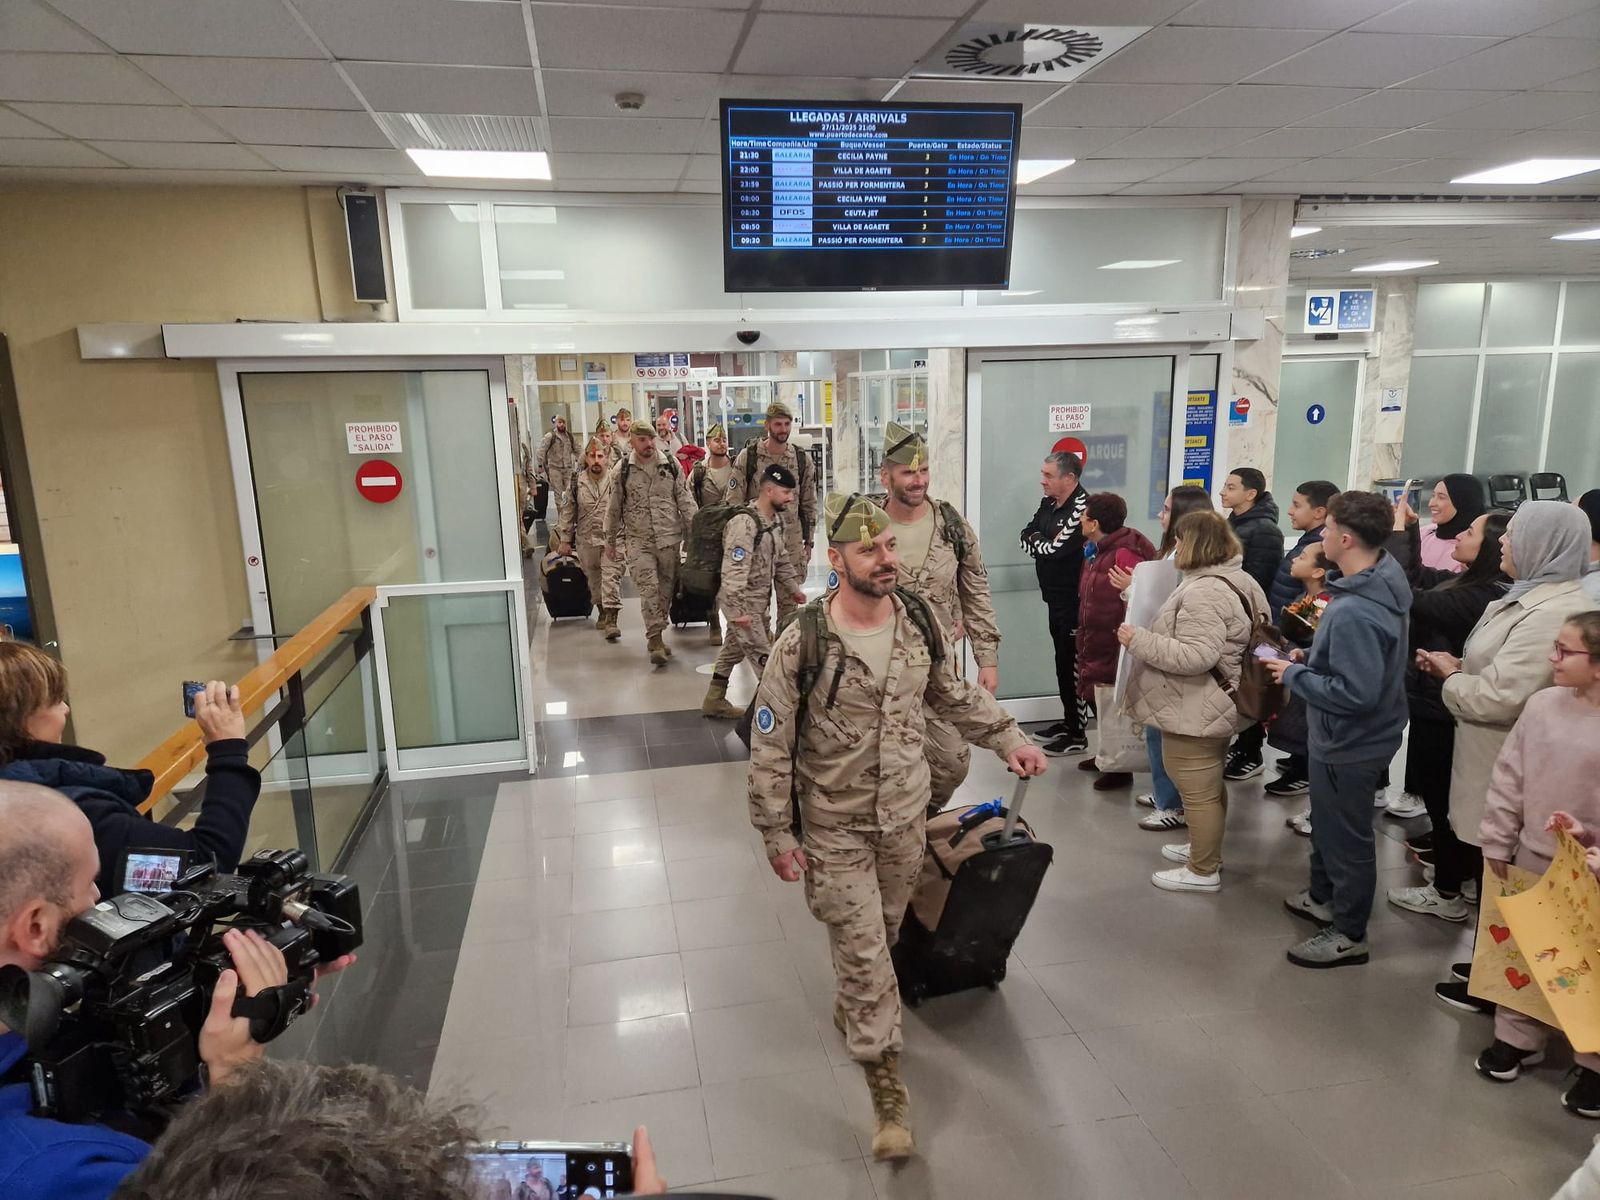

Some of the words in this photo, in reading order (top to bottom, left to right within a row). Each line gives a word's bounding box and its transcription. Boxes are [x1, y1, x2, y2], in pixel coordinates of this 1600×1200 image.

[790, 112, 845, 123] LLEGADAS
[848, 113, 853, 123] /
[855, 113, 907, 123] ARRIVALS
[809, 131, 888, 139] www.puertodeceuta.com
[957, 142, 1002, 150] Estado/Status
[818, 236, 842, 244] PASSIÓ
[354, 443, 394, 451] "SALIDA"
